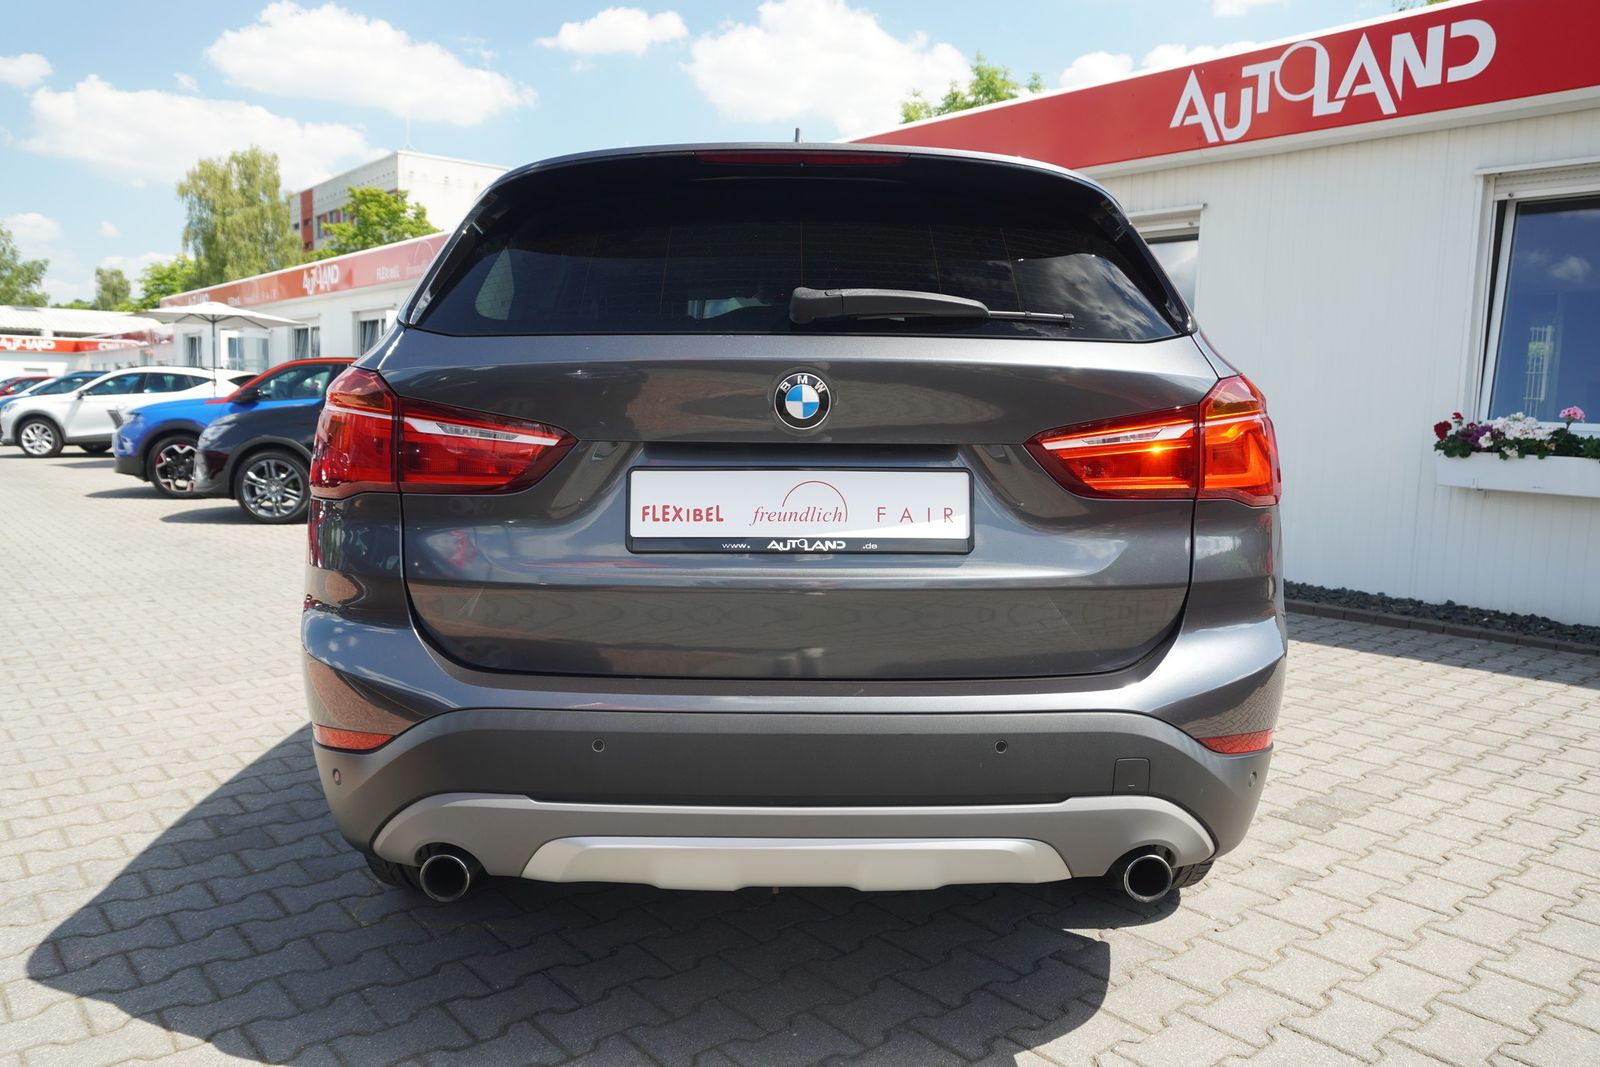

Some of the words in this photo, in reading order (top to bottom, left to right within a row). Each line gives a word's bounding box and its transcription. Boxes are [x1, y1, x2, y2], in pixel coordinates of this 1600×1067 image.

[1169, 19, 1497, 143] AUTOLAND
[779, 374, 826, 393] BMW
[642, 504, 724, 523] FLEXIBEL
[749, 504, 848, 526] freundlich
[877, 507, 954, 524] FAIR
[766, 536, 847, 552] AUTOLAND
